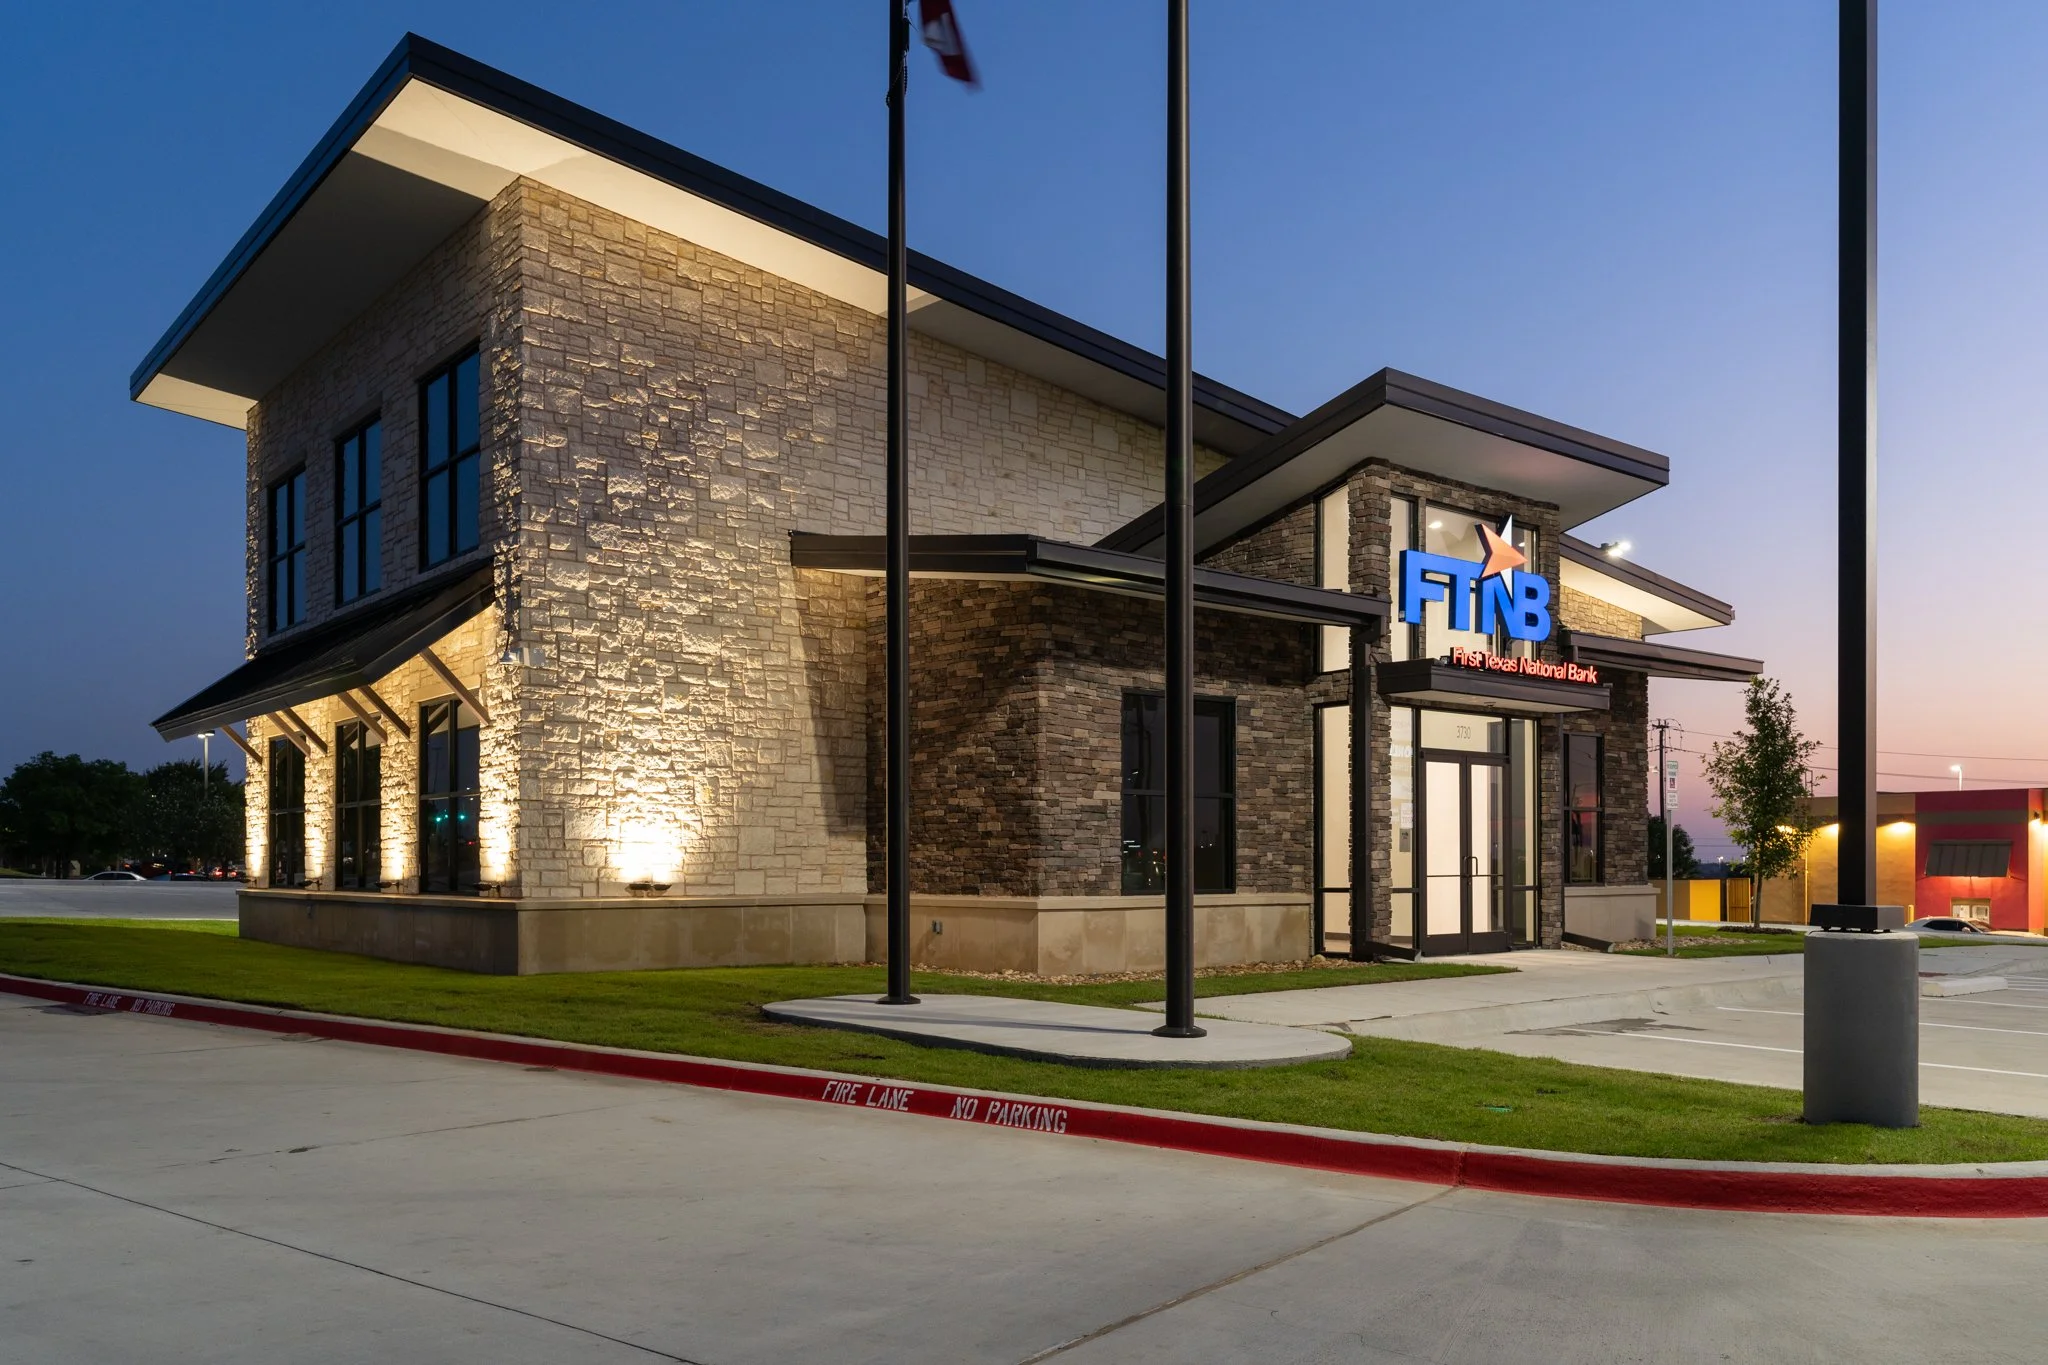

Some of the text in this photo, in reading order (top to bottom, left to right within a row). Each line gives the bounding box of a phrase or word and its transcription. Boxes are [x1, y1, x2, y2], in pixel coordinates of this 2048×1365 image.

[1398, 549, 1551, 642] FTNB
[1452, 647, 1598, 684] First Texas National Bank
[1456, 725, 1472, 740] 3730
[821, 1080, 1068, 1134] FIRE LANE NO PARKING
